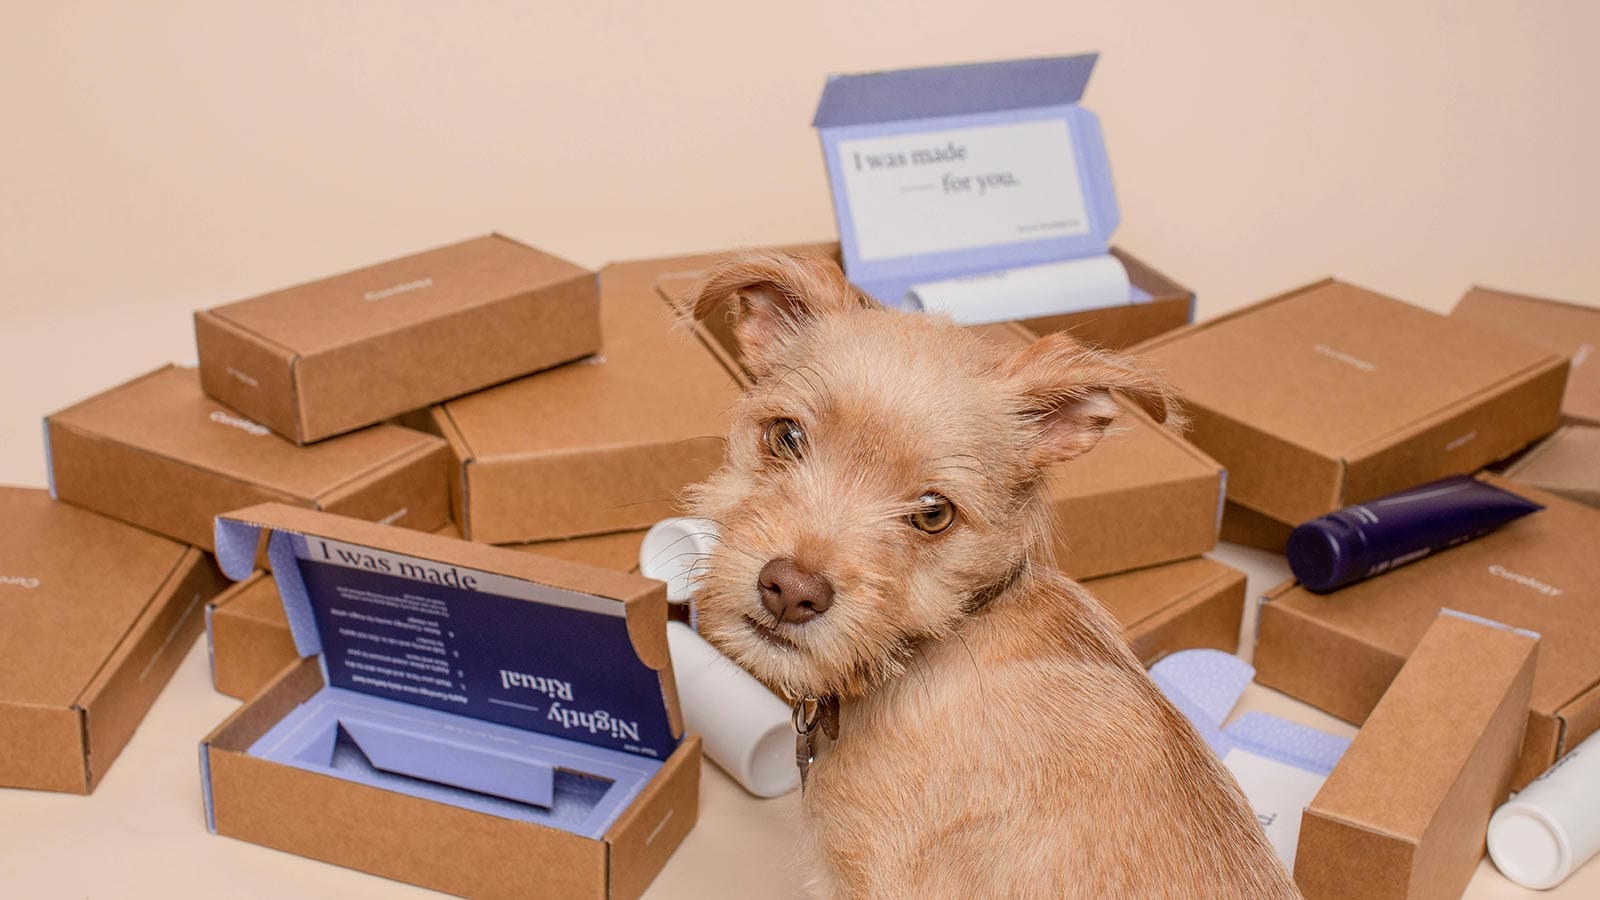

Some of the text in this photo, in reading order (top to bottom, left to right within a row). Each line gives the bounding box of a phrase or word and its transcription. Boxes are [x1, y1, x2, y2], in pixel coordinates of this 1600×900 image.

[853, 141, 969, 172] I was made
[941, 171, 1021, 195] for you.
[320, 541, 478, 592] I was made
[1487, 565, 1563, 597] Curology
[499, 669, 574, 701] Ritual
[547, 702, 641, 742] Nightly
